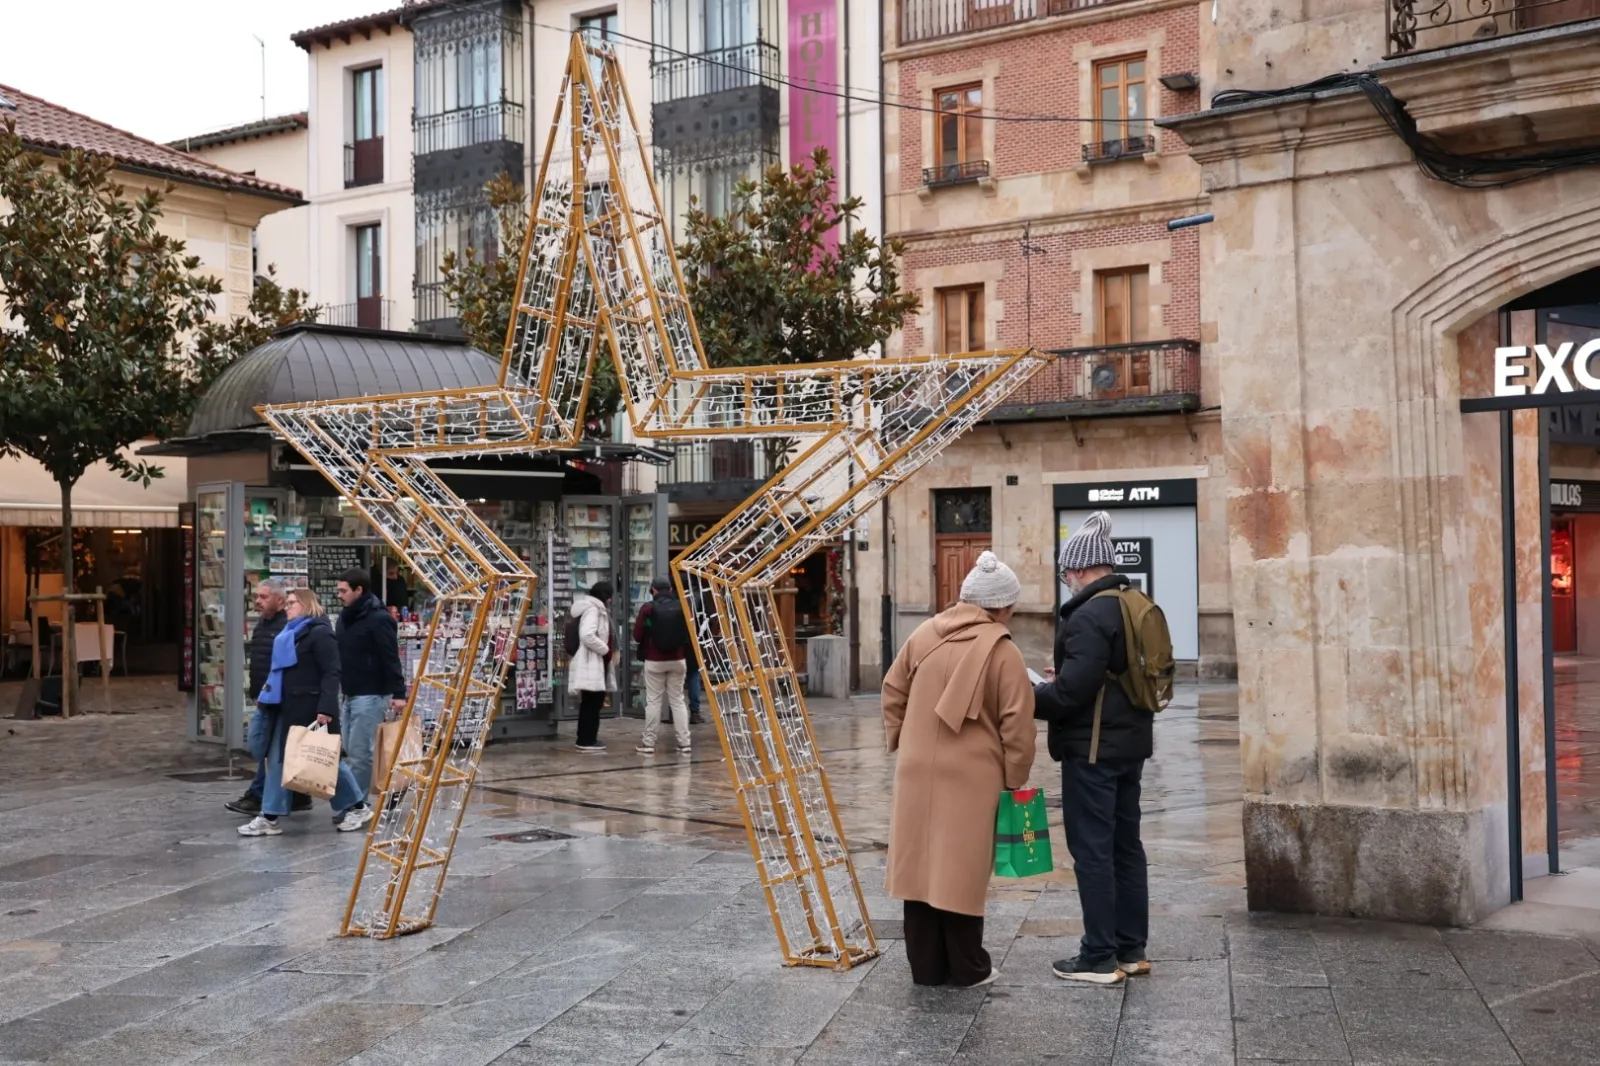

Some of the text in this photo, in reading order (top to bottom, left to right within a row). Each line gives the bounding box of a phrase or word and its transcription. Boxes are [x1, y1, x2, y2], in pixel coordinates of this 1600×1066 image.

[801, 12, 823, 143] HOTEL
[1129, 487, 1159, 501] ATM
[1115, 542, 1140, 552] ATM
